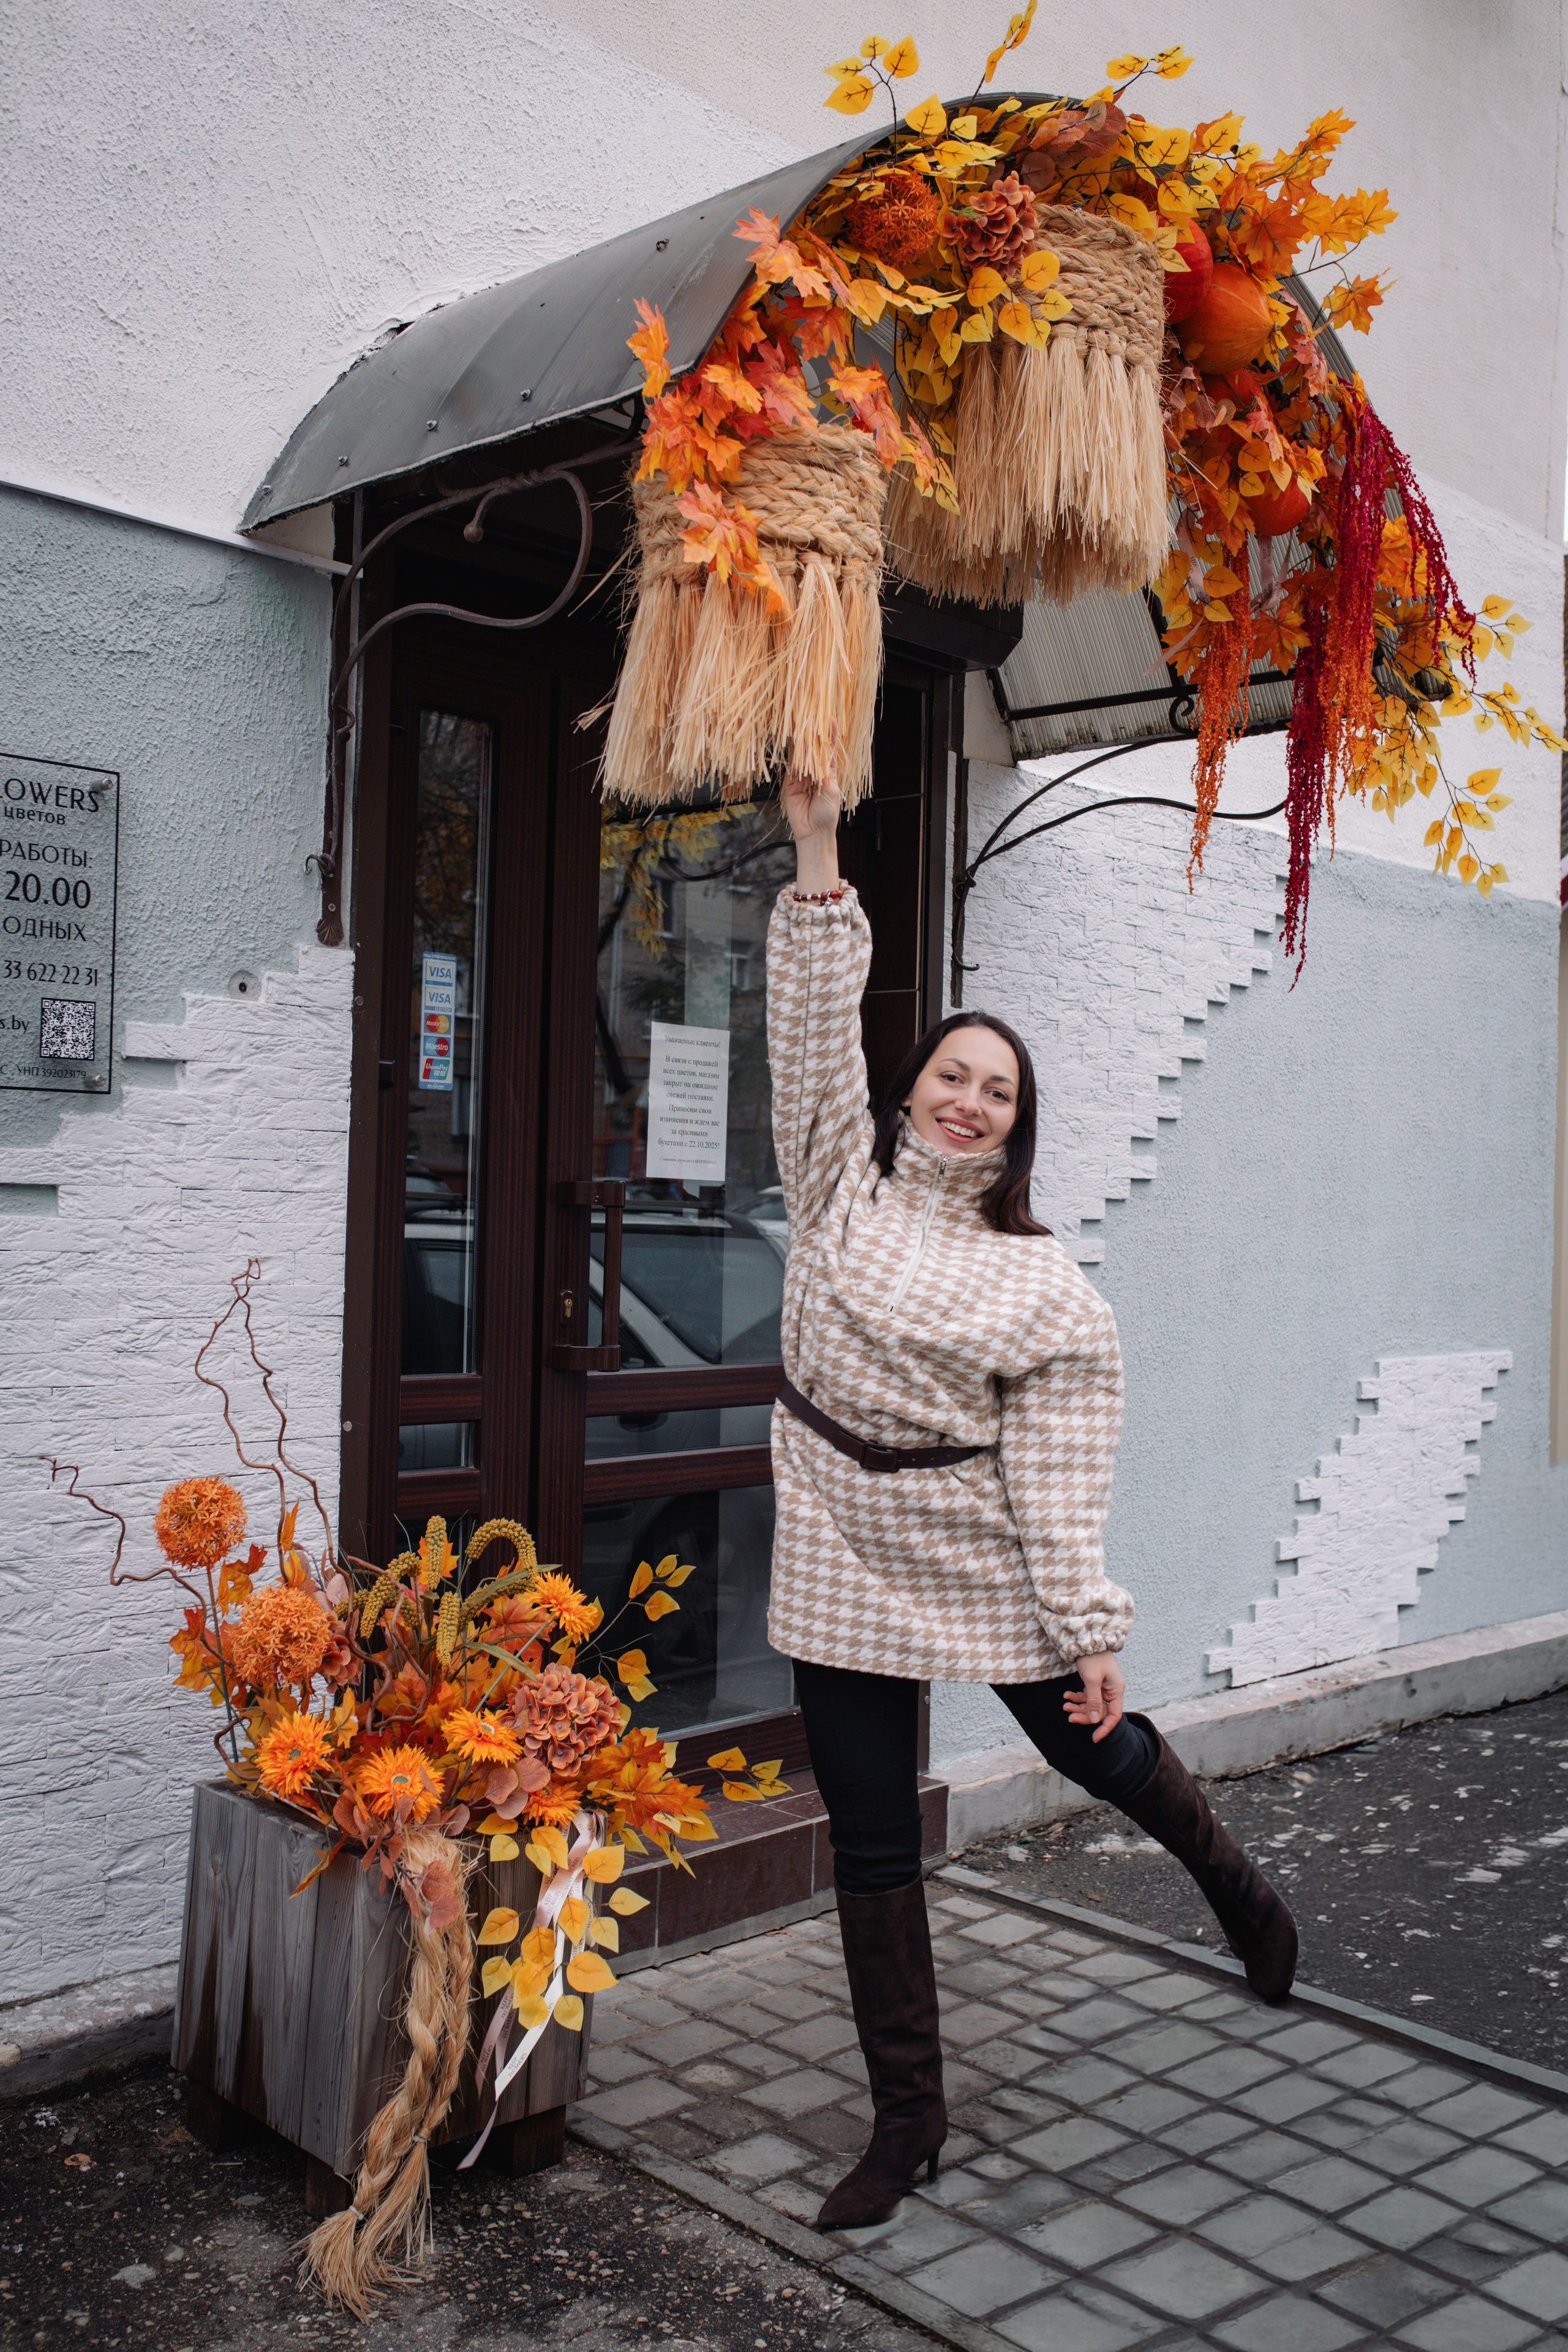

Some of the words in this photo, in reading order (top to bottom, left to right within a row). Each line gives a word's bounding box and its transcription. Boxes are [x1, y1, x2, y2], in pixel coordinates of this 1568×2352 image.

[0, 778, 99, 812] OWERS
[4, 806, 66, 825] цветов
[0, 839, 92, 869] РАБОТЫ:
[5, 870, 91, 909] 20.00
[4, 960, 21, 979] 33
[28, 962, 56, 982] 622
[62, 965, 80, 985] 22
[85, 967, 98, 986] 31
[429, 966, 451, 978] VISA
[428, 992, 450, 1003] VISA
[665, 1035, 695, 1045] Уважаемые
[17, 1066, 39, 1076] УНП
[41, 1068, 86, 1079] 392023179
[426, 1063, 448, 1072] UnionPay
[669, 1104, 697, 1113] Приносим
[658, 1138, 683, 1147] букетами
[689, 1140, 720, 1149] 22.10.2025!
[544, 1893, 552, 1905] KEEP
[546, 1890, 561, 1915] FLOWERS
[501, 1993, 514, 2018] FLOWER
[502, 2011, 514, 2038] FLOWERS
[481, 2045, 492, 2071] FLOWERS
[508, 2057, 518, 2070] KEEP
[508, 2053, 527, 2077] FLOWERS
